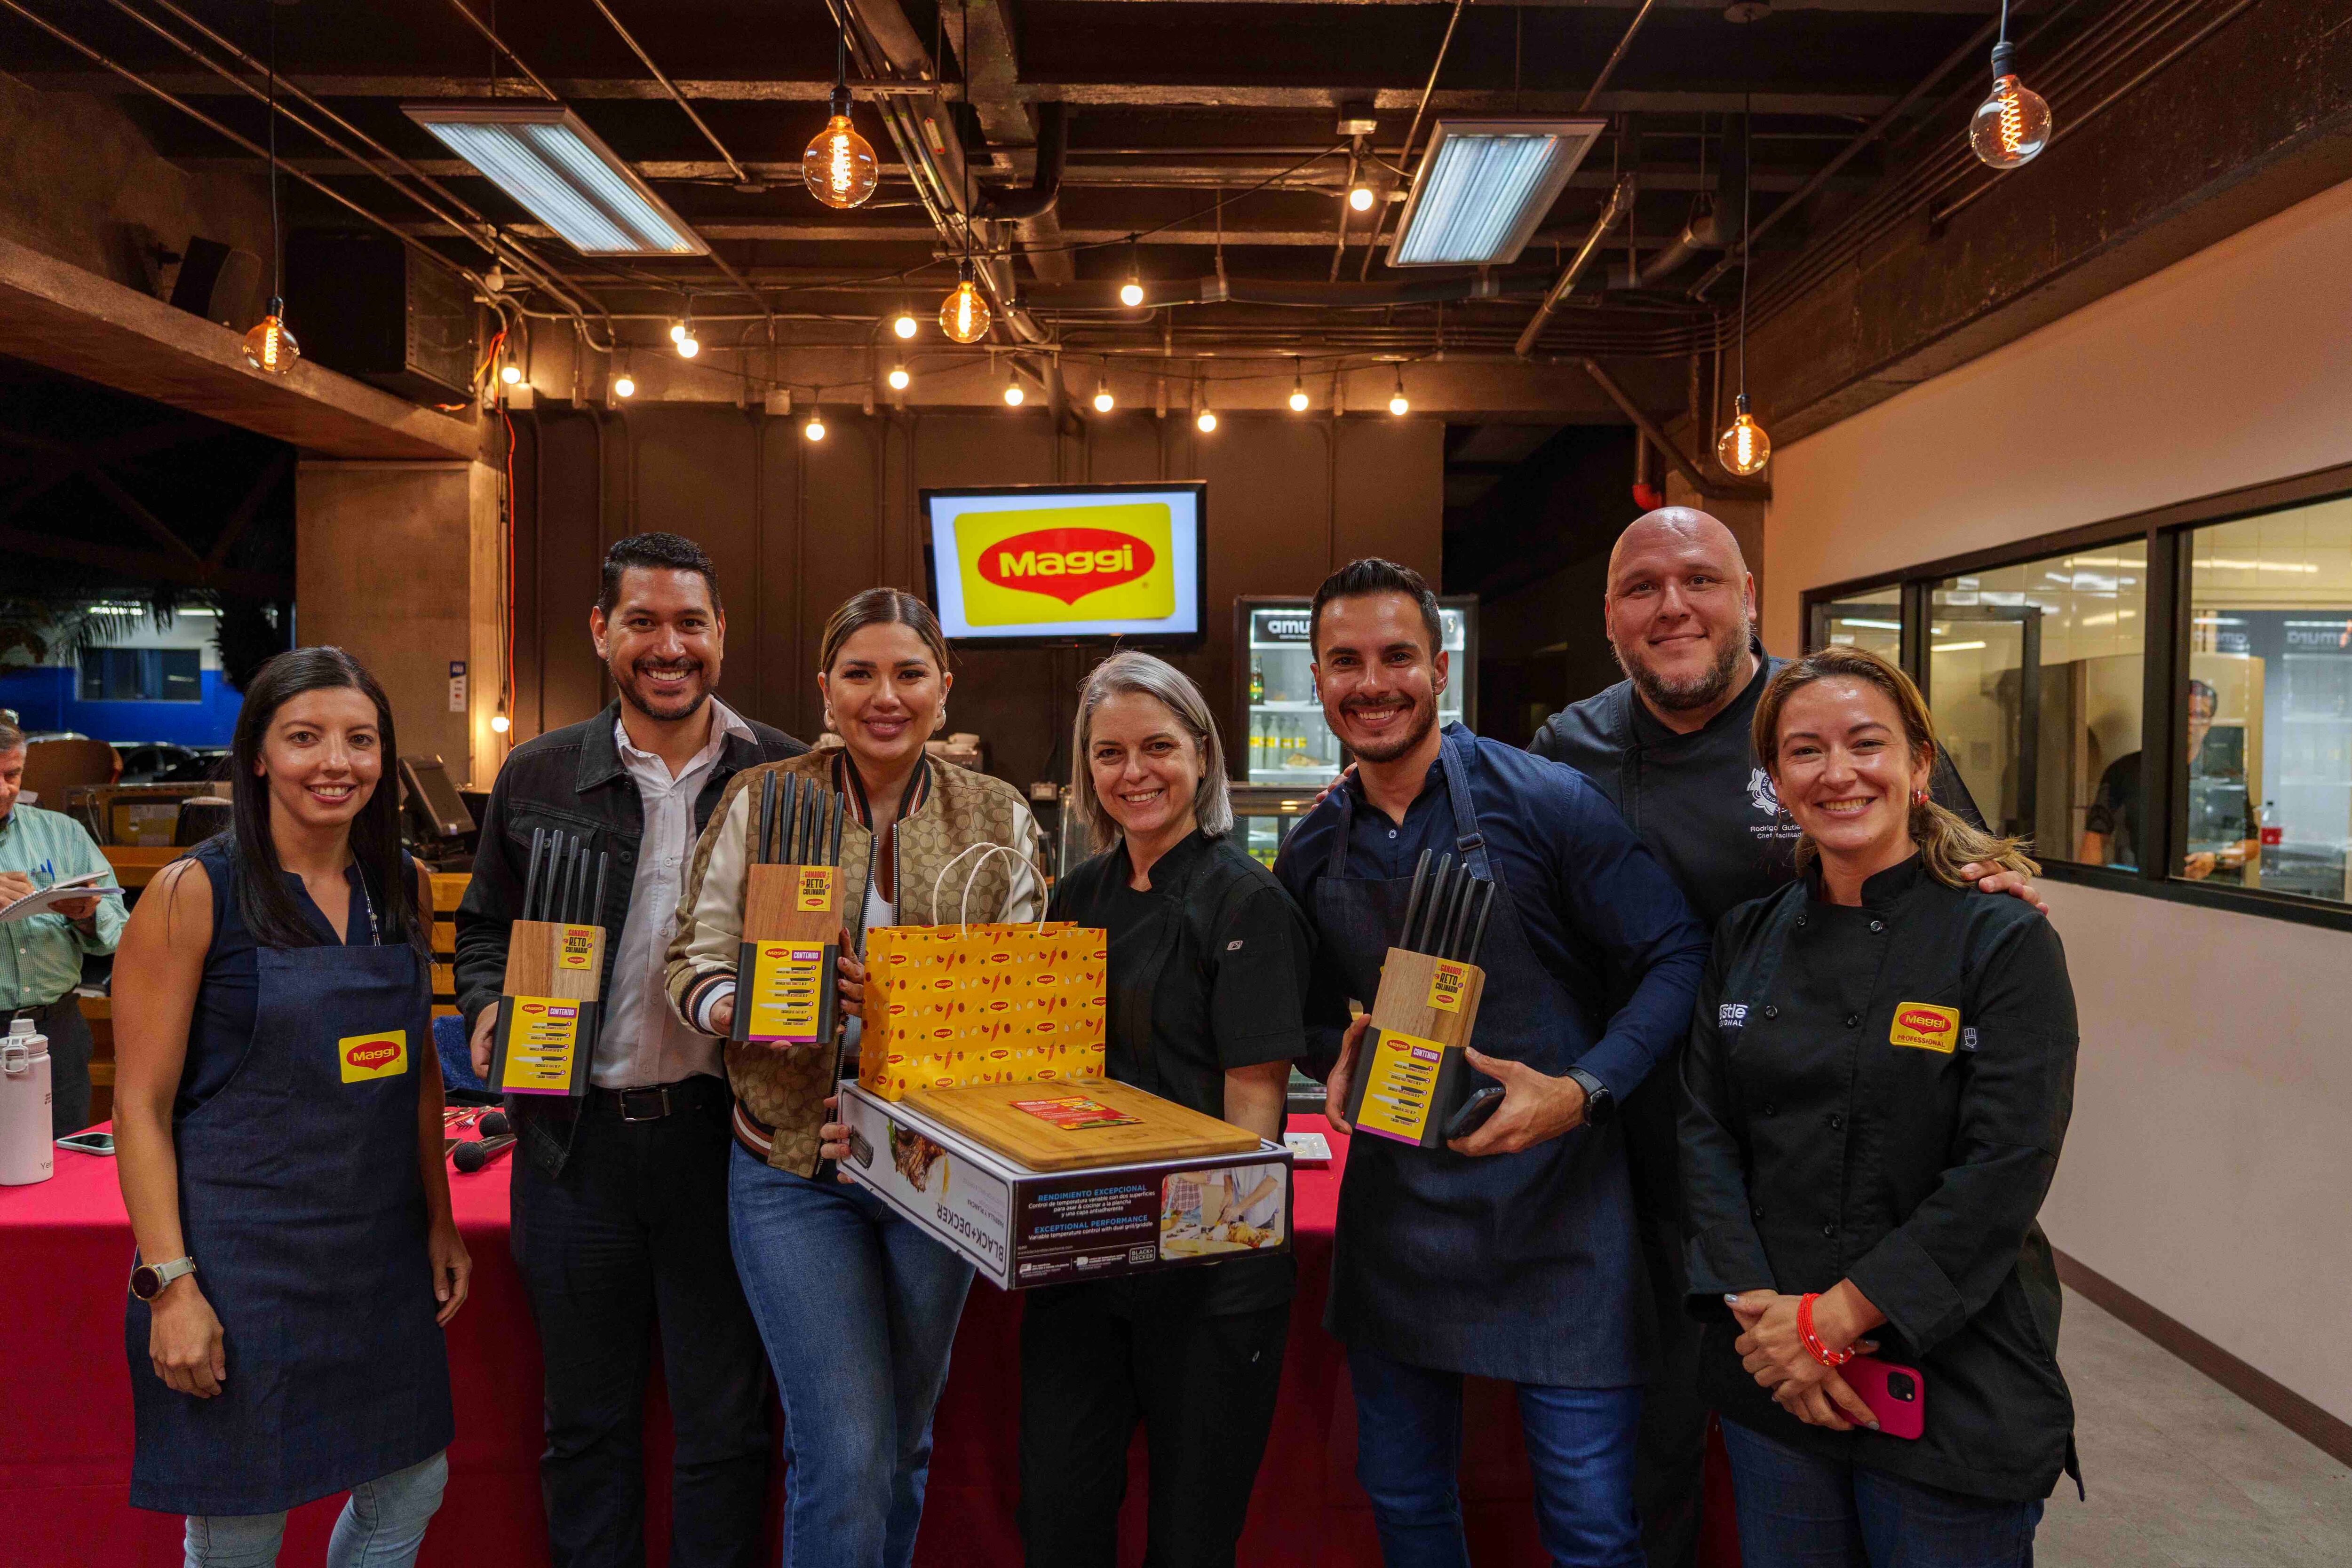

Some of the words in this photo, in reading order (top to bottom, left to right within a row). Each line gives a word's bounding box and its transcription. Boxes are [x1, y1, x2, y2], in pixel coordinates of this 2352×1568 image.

[999, 544, 1133, 578] Maggi
[806, 879, 824, 888] RETO
[569, 937, 587, 947] RETO
[1440, 973, 1458, 985] RETO
[1435, 982, 1458, 993] CULINARIO
[1906, 1014, 1946, 1029] Maggi
[1897, 1035, 1946, 1047] PROFESSIONAL
[353, 1046, 395, 1061] Maggi
[1414, 1048, 1438, 1060] CONTENIDO
[1038, 1190, 1092, 1201] RENDIMIENTO
[1094, 1184, 1147, 1196] EXCEPCIONAL
[1034, 1222, 1089, 1234] EXCEPTIONAL
[1091, 1214, 1148, 1227] PERFORMANCE
[1125, 1221, 1153, 1230] grill/griddle
[937, 1203, 1004, 1262] BLACK+DECKER
